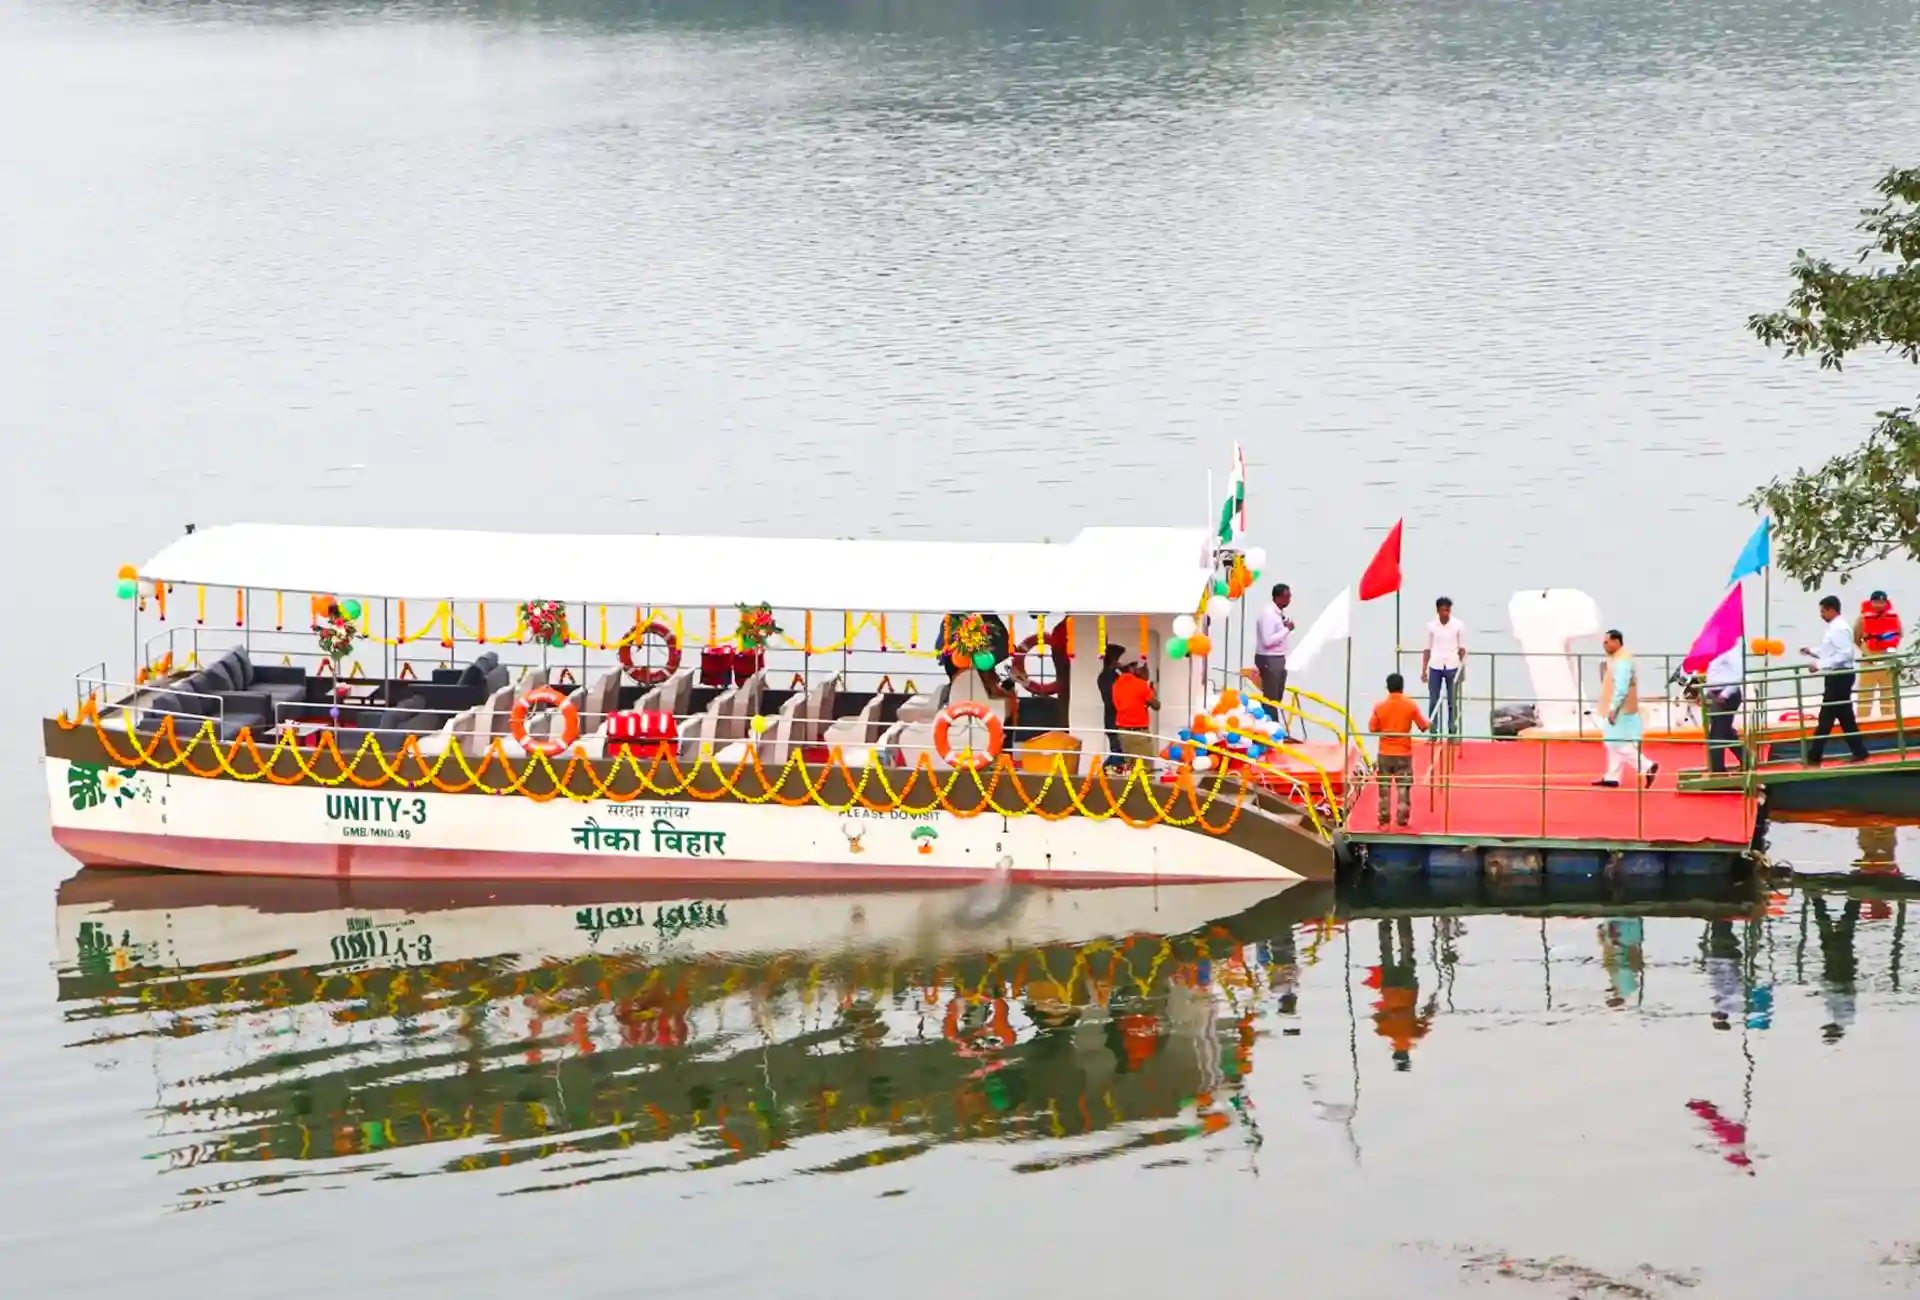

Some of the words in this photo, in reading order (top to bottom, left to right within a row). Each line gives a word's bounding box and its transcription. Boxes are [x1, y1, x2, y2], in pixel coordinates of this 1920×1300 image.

[326, 794, 426, 824] UNITY-3
[608, 804, 645, 818] सरदार
[650, 802, 690, 819] सरोवर
[571, 816, 641, 851] नौका
[651, 819, 727, 857] विहार
